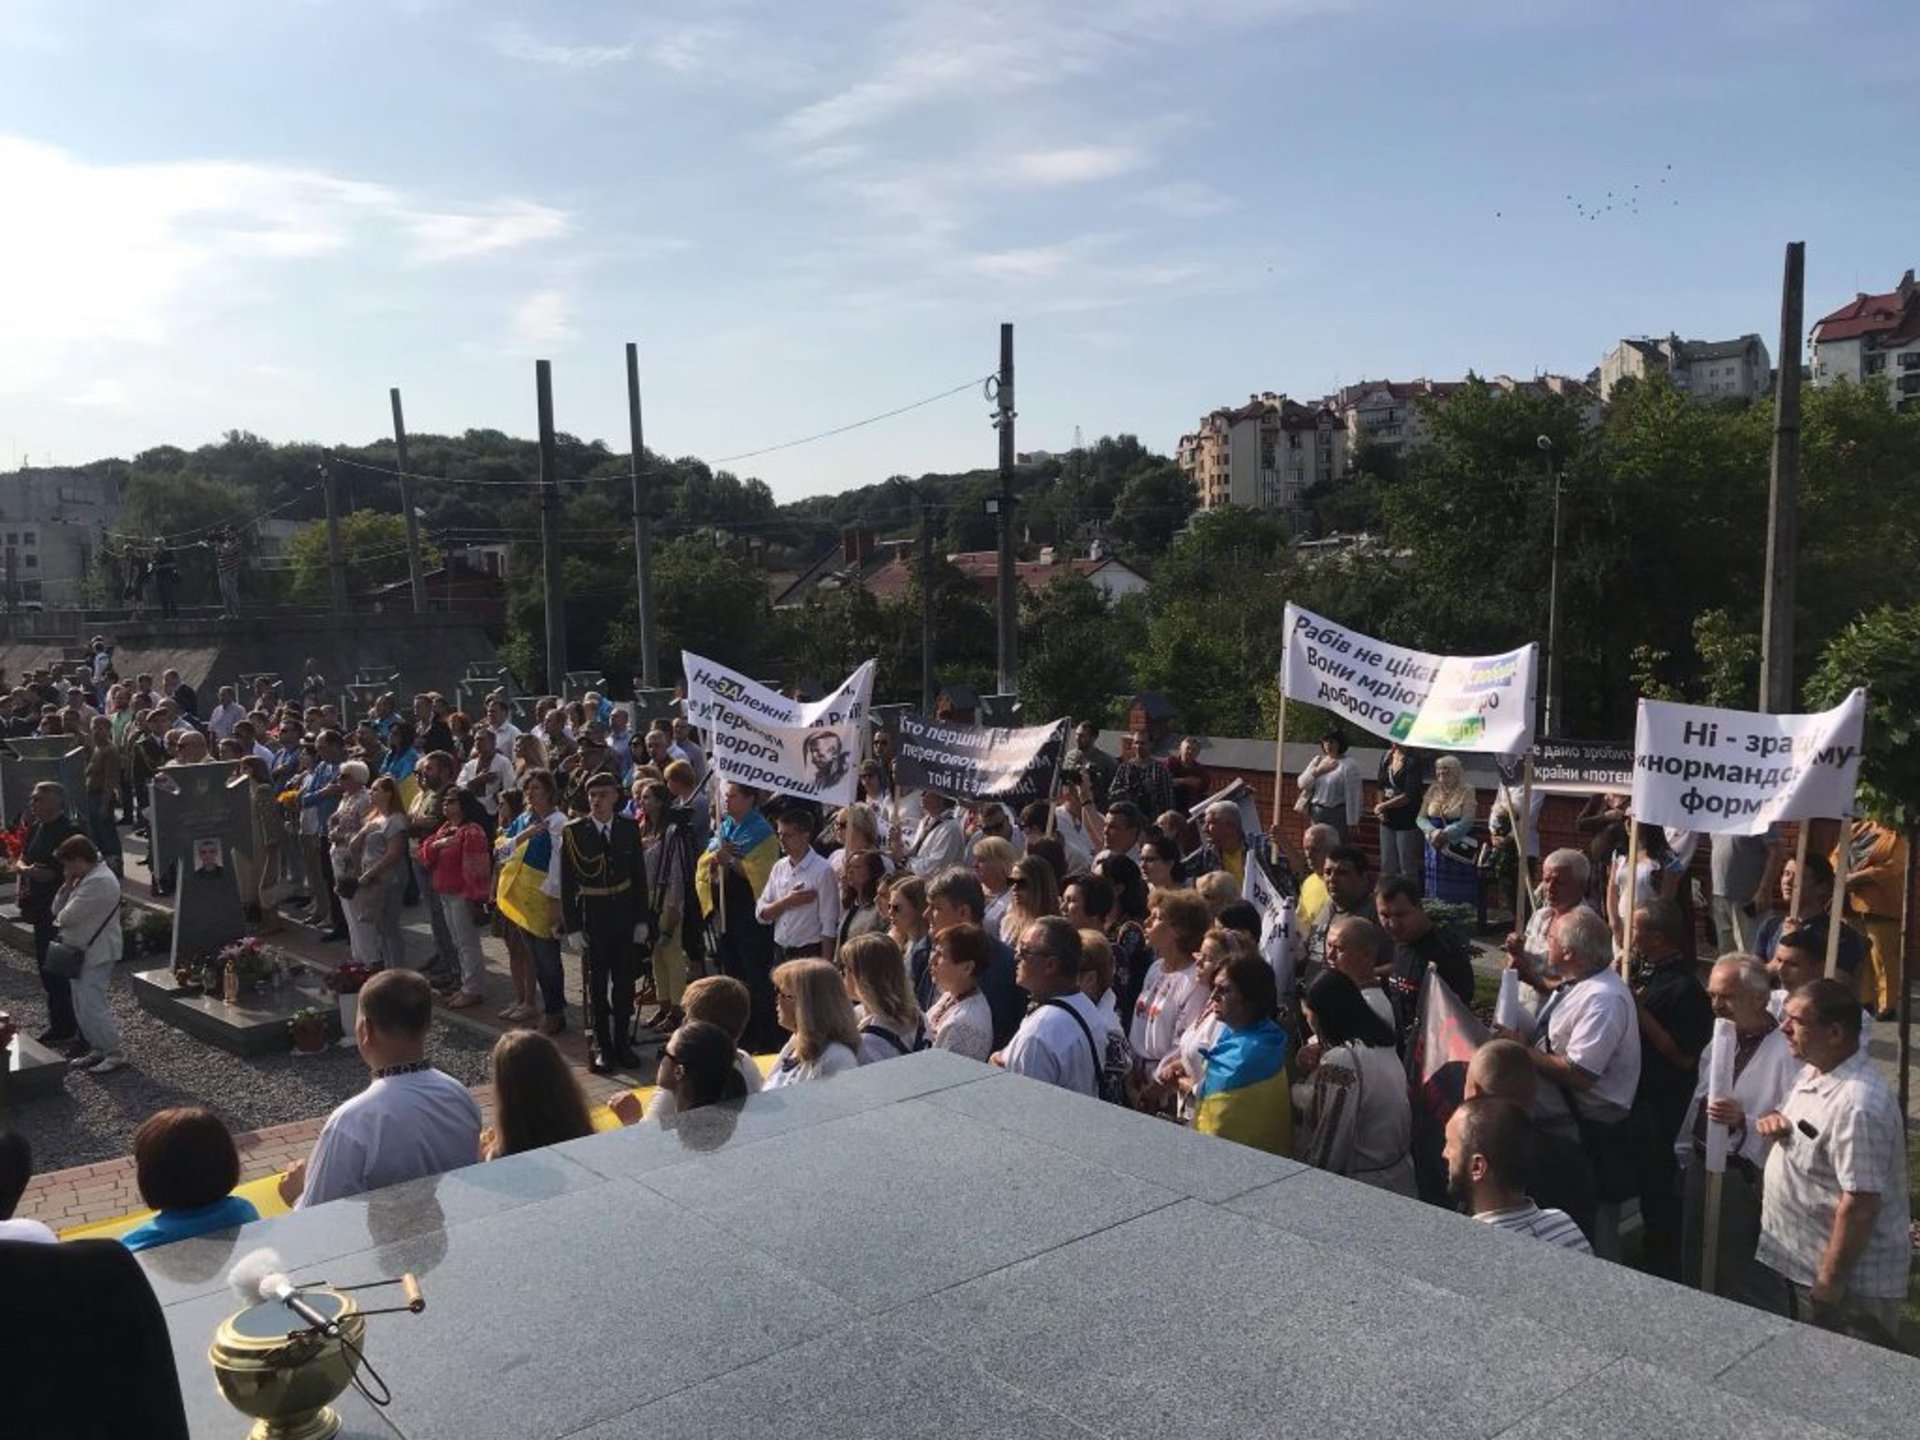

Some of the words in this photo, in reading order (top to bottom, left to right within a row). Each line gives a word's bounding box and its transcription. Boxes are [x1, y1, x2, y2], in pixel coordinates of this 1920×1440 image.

[1294, 615, 1350, 654] Рабів
[1354, 646, 1383, 666] не
[1307, 646, 1356, 682] Вони
[1358, 672, 1429, 708] мріют
[1318, 680, 1395, 725] доброго
[926, 725, 989, 749] перший
[1683, 720, 1718, 747] Ні
[716, 733, 780, 763] ворога
[1544, 744, 1580, 760] дамо
[719, 755, 821, 797] випросиш!
[928, 769, 951, 789] той
[1533, 764, 1580, 782] країни
